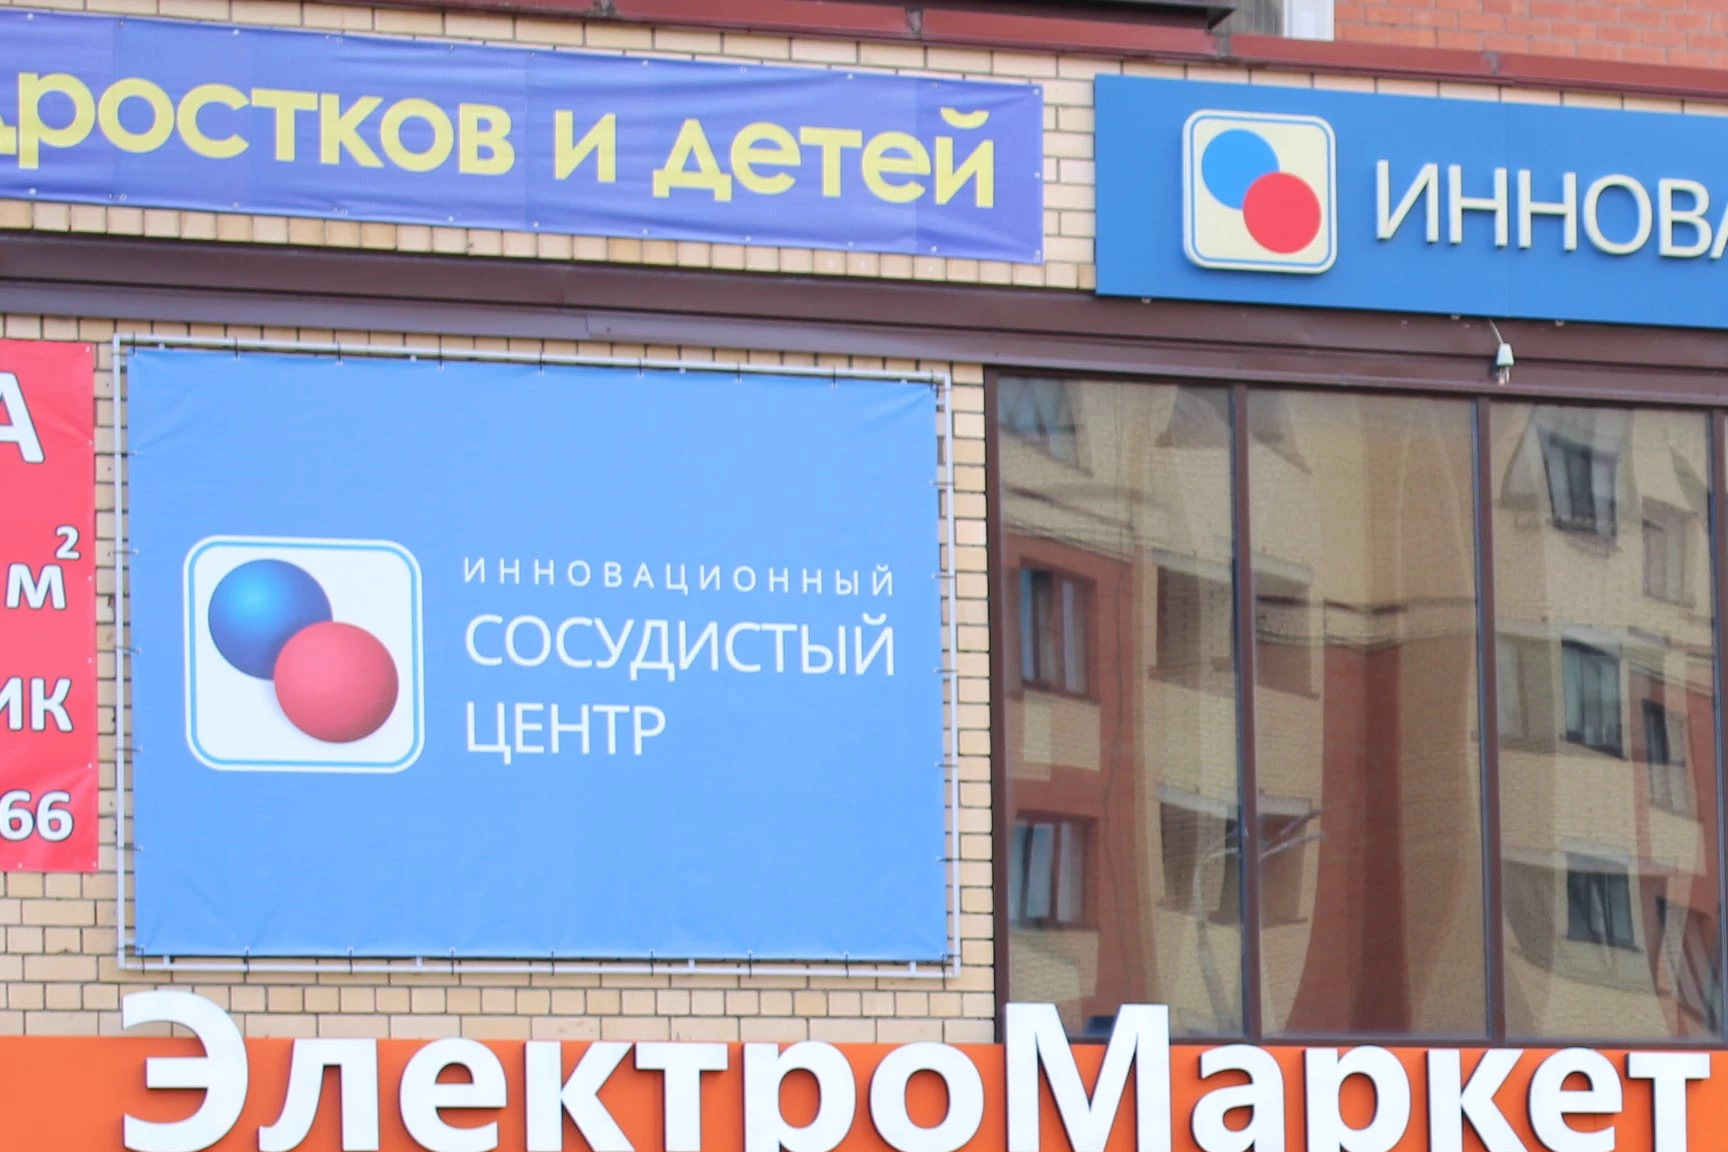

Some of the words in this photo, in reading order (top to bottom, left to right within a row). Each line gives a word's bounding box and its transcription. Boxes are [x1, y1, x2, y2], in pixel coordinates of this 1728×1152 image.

[0, 72, 515, 175] ростков
[554, 109, 617, 183] и
[652, 106, 996, 209] детей
[463, 556, 894, 597] ИННОВАЦИОННЫЙ
[464, 613, 895, 682] СОСУДИСТЫЙ
[466, 701, 667, 765] ЦЕНТР
